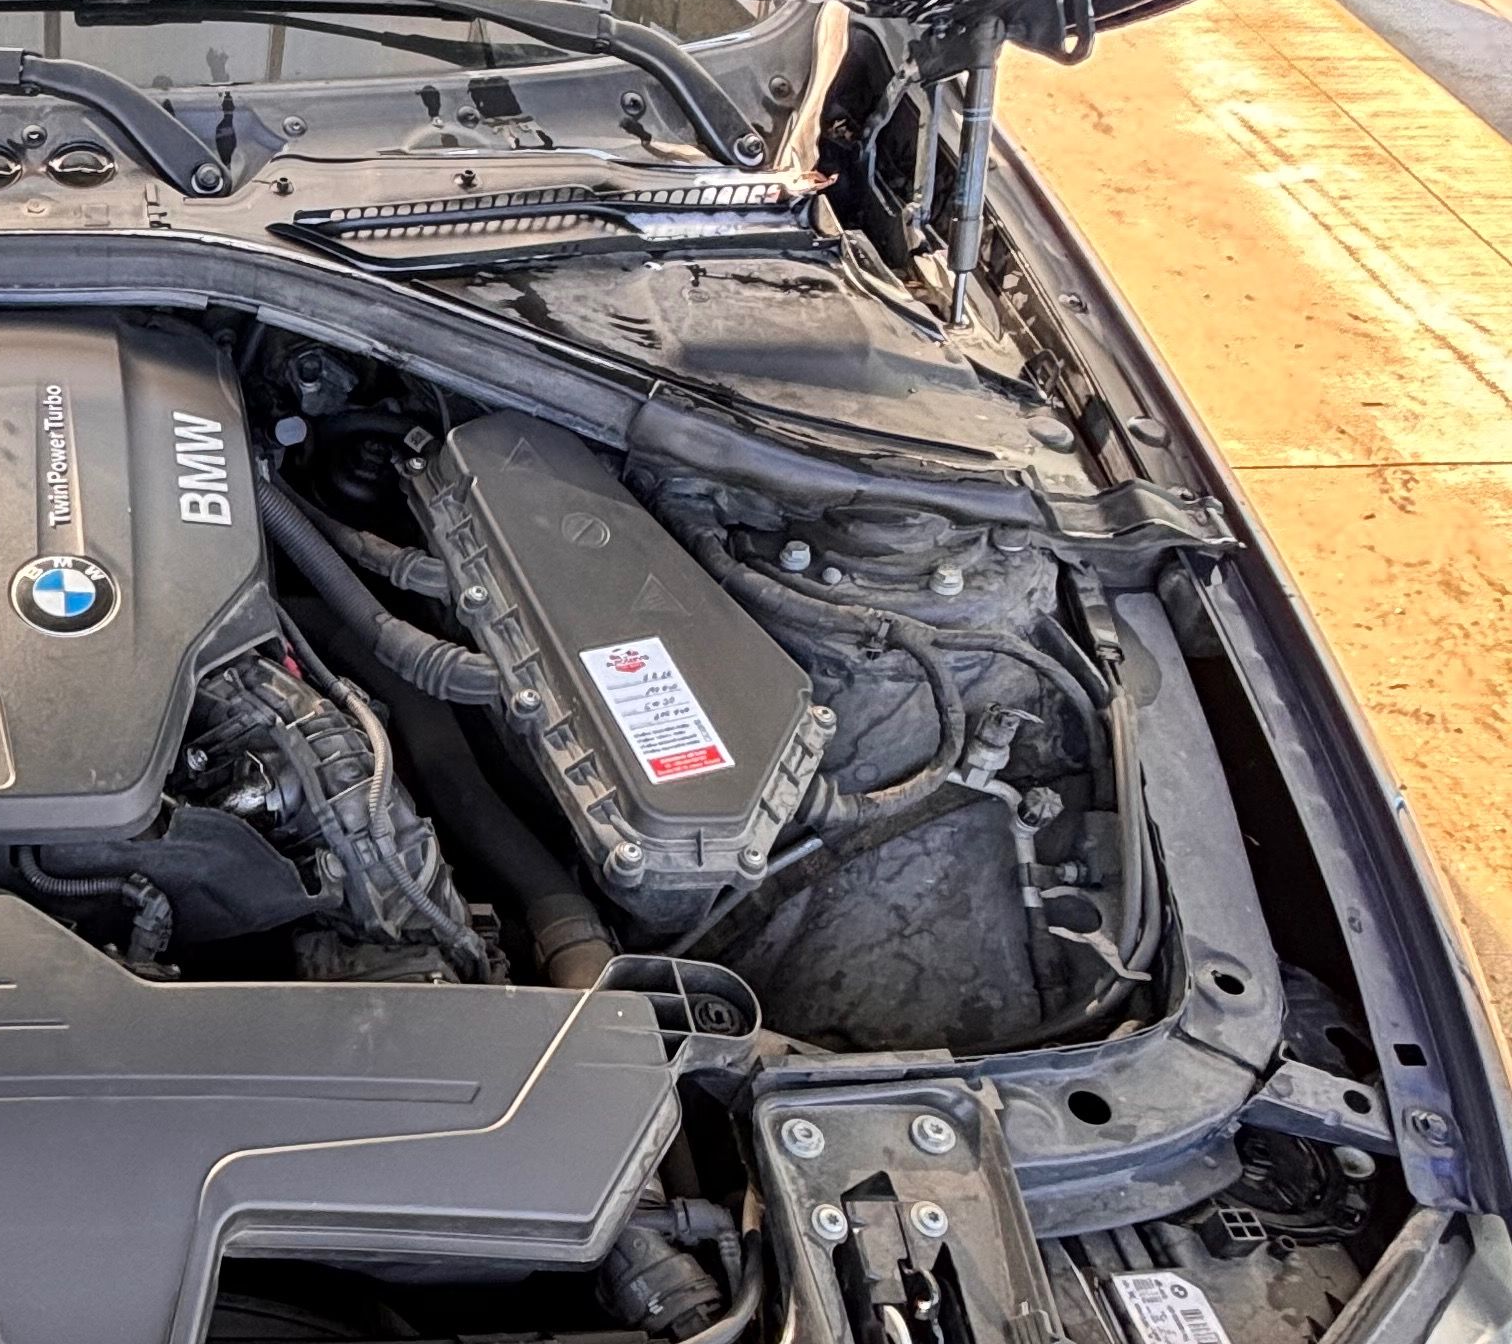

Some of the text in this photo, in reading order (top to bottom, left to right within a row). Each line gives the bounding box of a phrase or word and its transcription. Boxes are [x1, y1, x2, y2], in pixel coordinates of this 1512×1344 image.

[42, 384, 72, 527] TwinPowerTurbo
[172, 410, 232, 525] BMW
[24, 557, 106, 581] BMW
